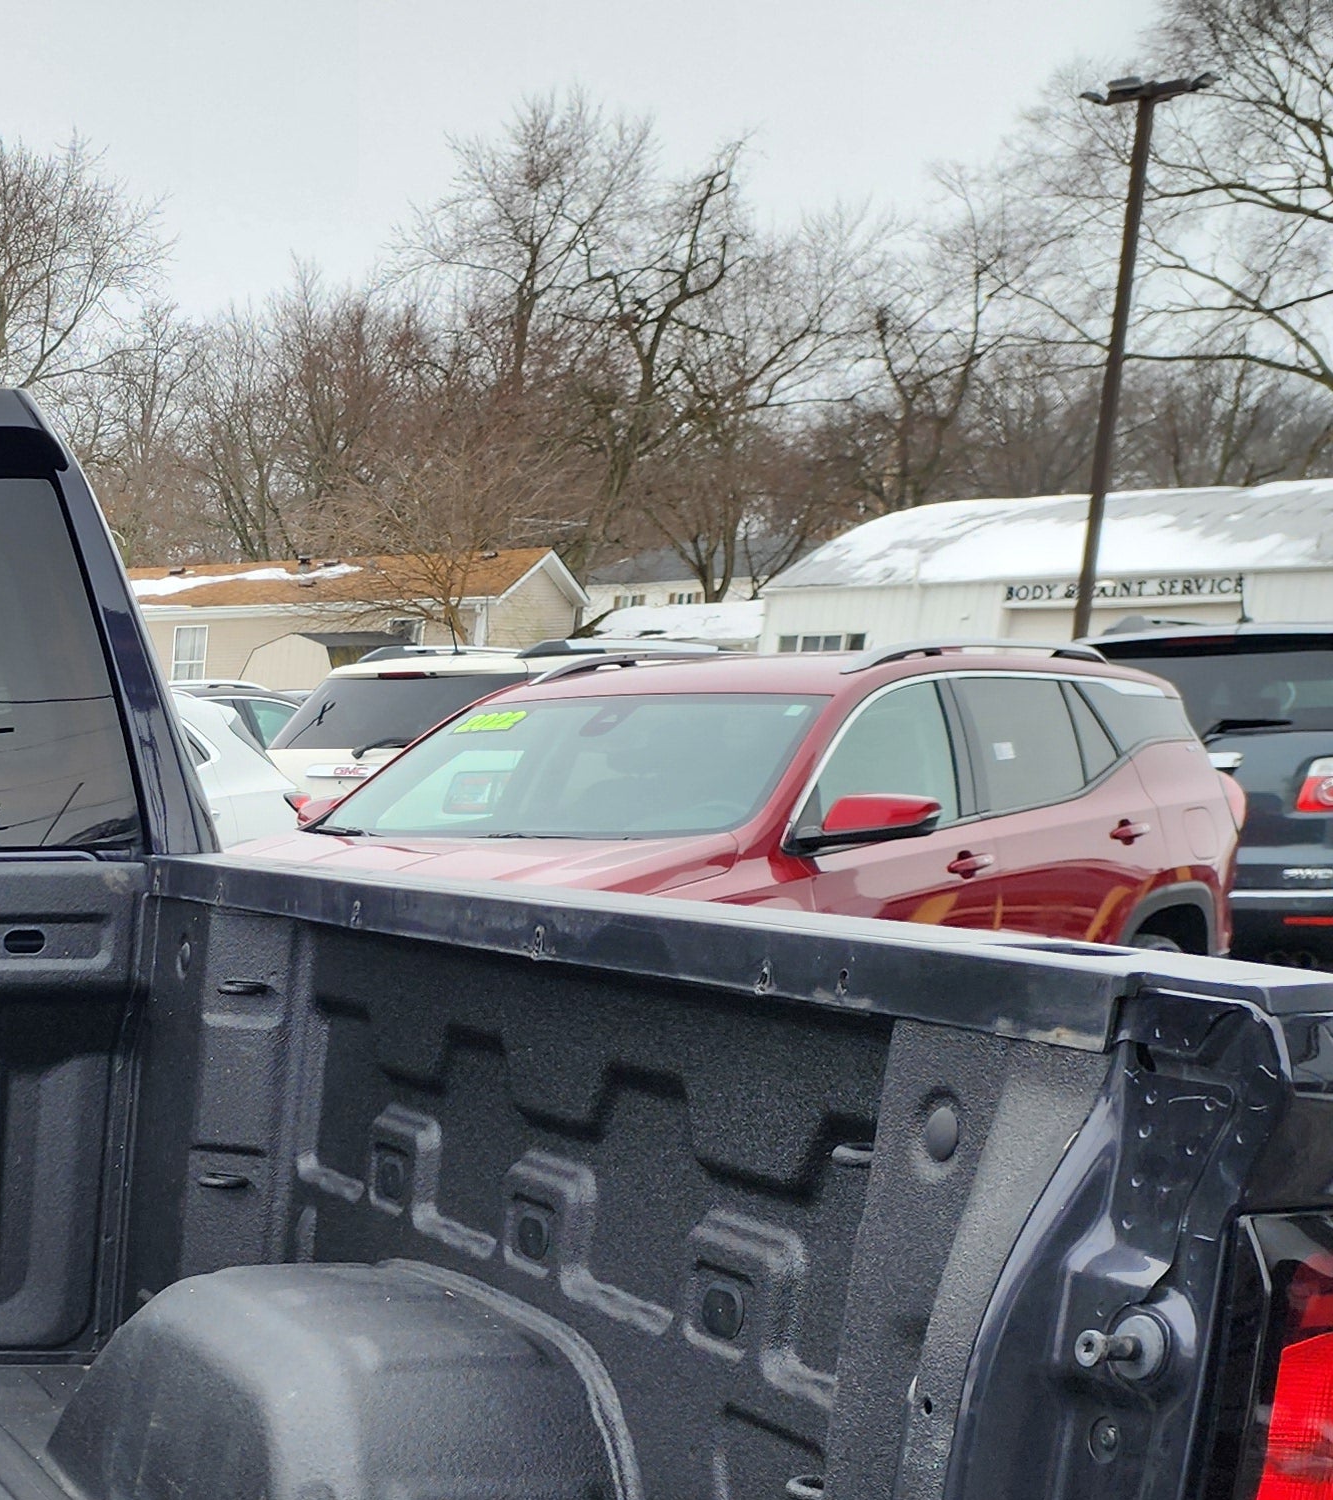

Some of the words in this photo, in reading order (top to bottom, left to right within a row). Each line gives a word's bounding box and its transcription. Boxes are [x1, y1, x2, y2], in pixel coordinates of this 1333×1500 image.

[1006, 584, 1057, 601] BODY
[1064, 583, 1081, 599] &
[1089, 579, 1147, 598] AINT
[1157, 577, 1243, 596] SERVICE
[453, 711, 527, 733] 2022
[333, 766, 369, 776] GMC
